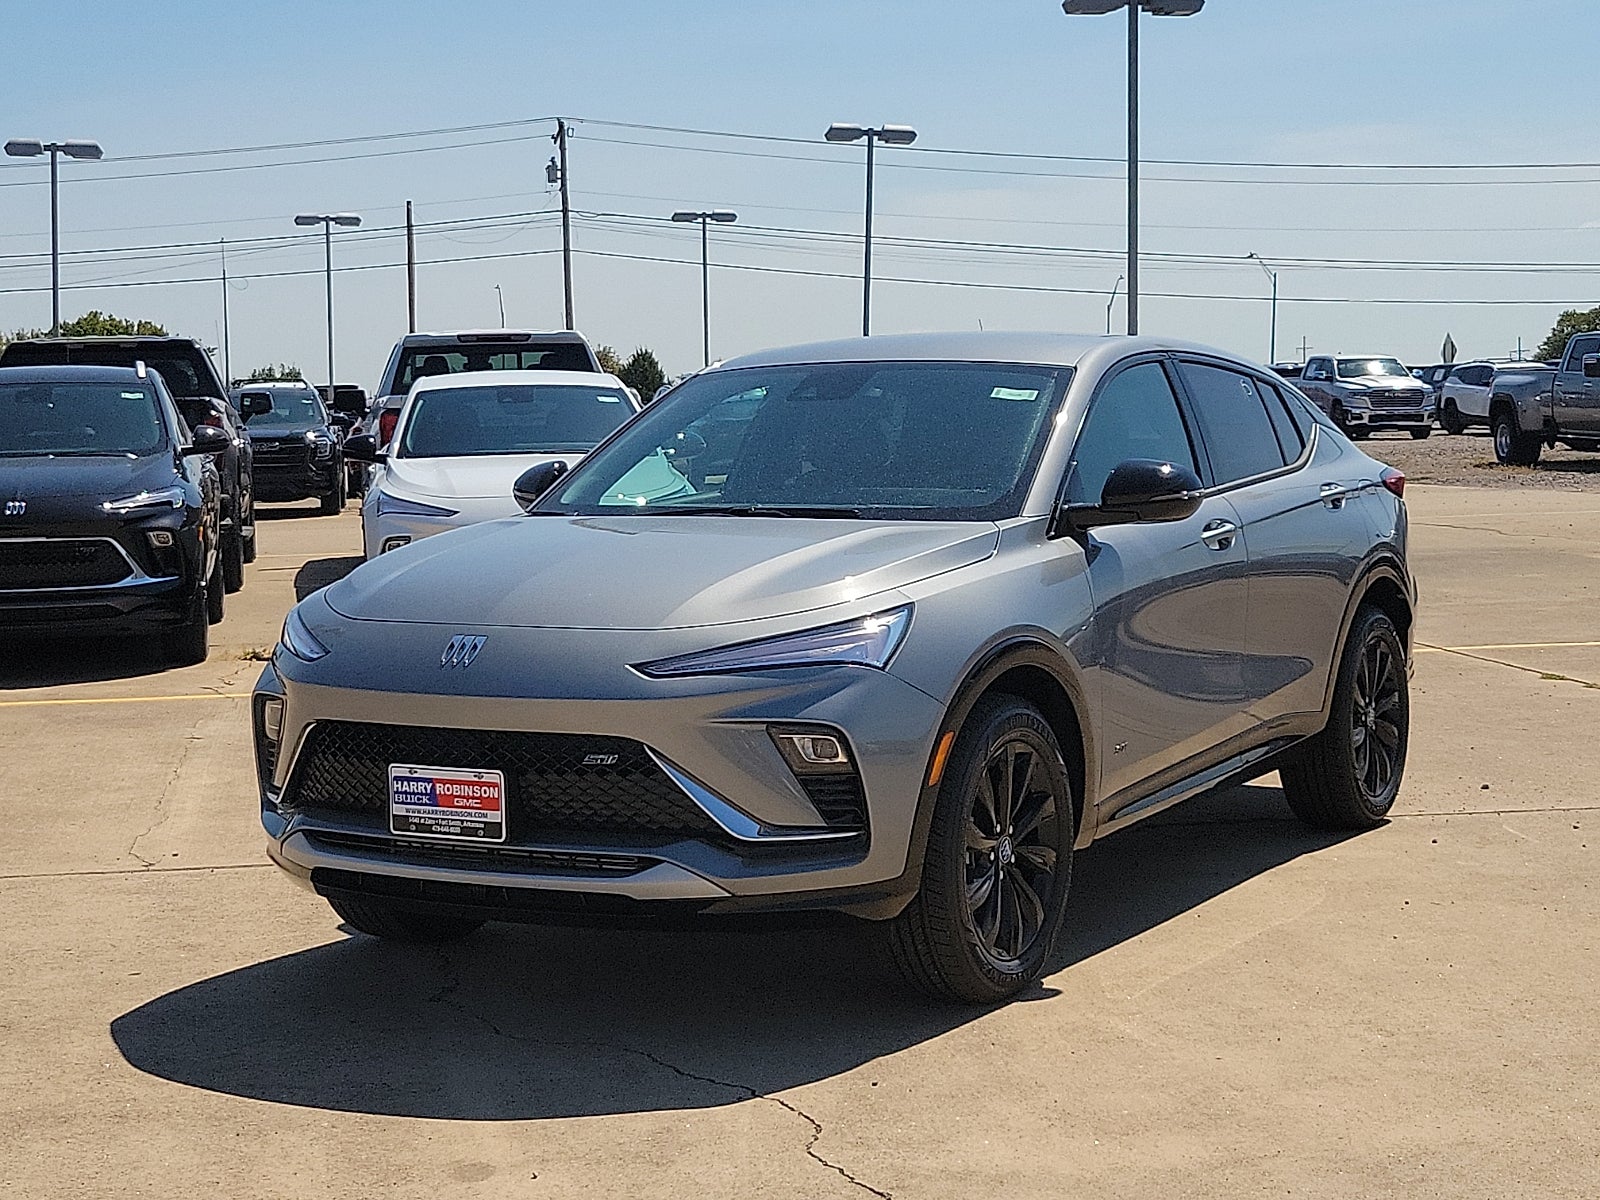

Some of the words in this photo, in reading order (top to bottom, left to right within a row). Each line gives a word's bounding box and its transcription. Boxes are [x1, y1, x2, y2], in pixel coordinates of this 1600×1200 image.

[393, 780, 433, 794] HARRY
[436, 783, 499, 798] ROBINSON
[395, 793, 431, 804] BUICK
[454, 798, 482, 807] GMC
[405, 807, 489, 819] WWW.HARRYROBINSON.COM
